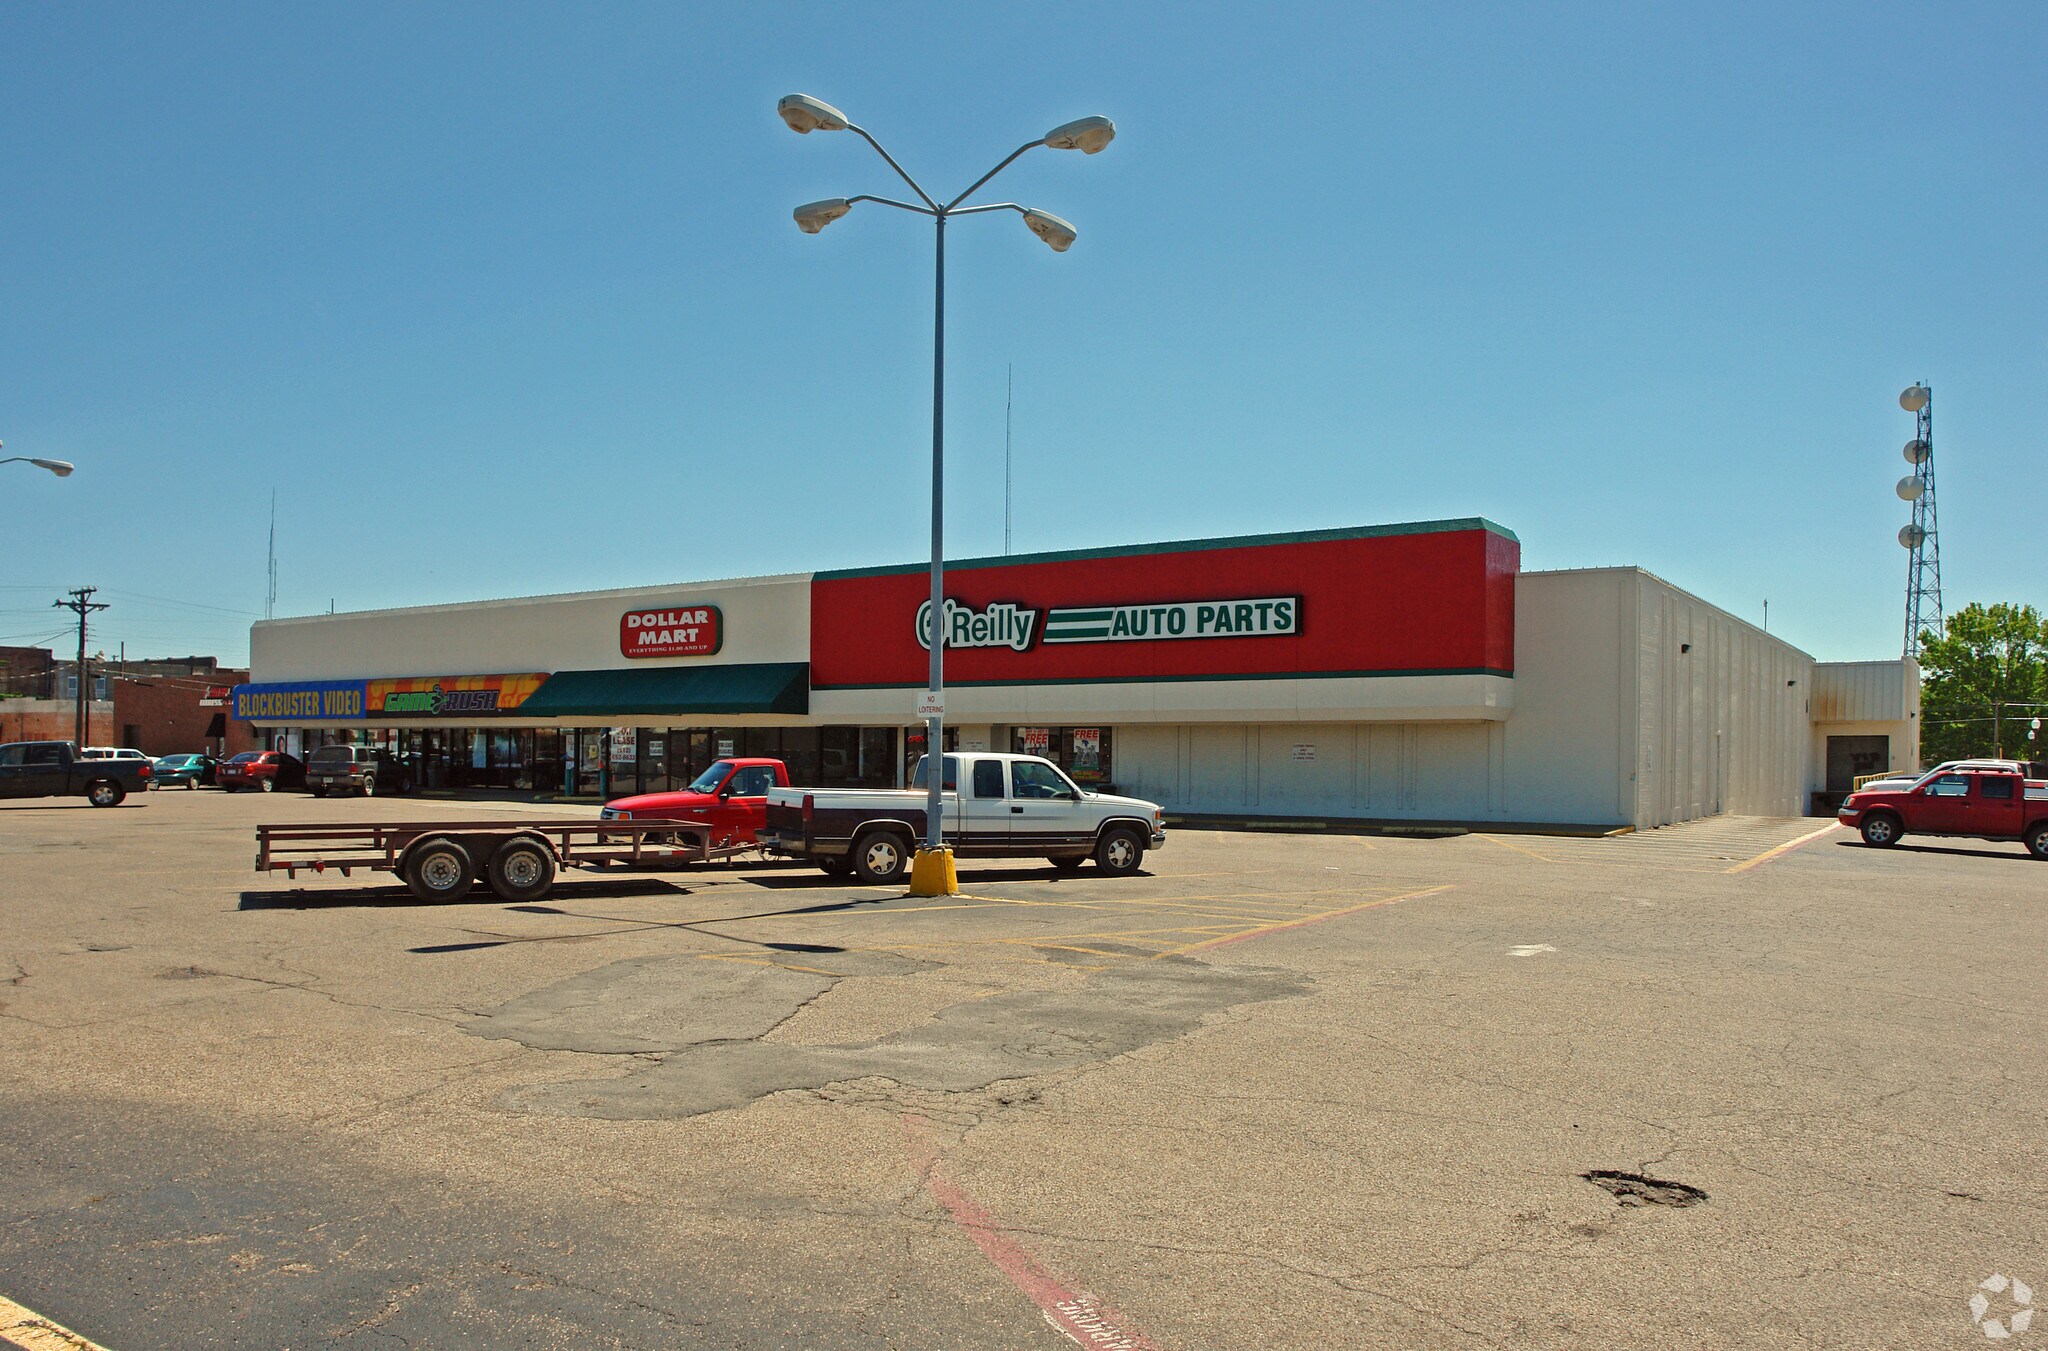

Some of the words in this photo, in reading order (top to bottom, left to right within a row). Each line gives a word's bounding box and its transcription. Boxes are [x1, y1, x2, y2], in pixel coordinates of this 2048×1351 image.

[627, 610, 709, 628] DOLLAR
[919, 603, 1031, 646] O'Reilly
[1112, 607, 1186, 636] AUTO
[1197, 602, 1292, 633] PARTS
[638, 628, 699, 645] MART
[238, 691, 320, 717] BLOCKBUSTER
[323, 690, 361, 715] VIDEO
[384, 693, 437, 712] GAME
[445, 690, 499, 711] RUSH
[613, 736, 635, 745] LEASE
[1024, 733, 1048, 745] FREE
[1074, 730, 1099, 739] FREE
[1057, 1299, 1134, 1351] ARKING
